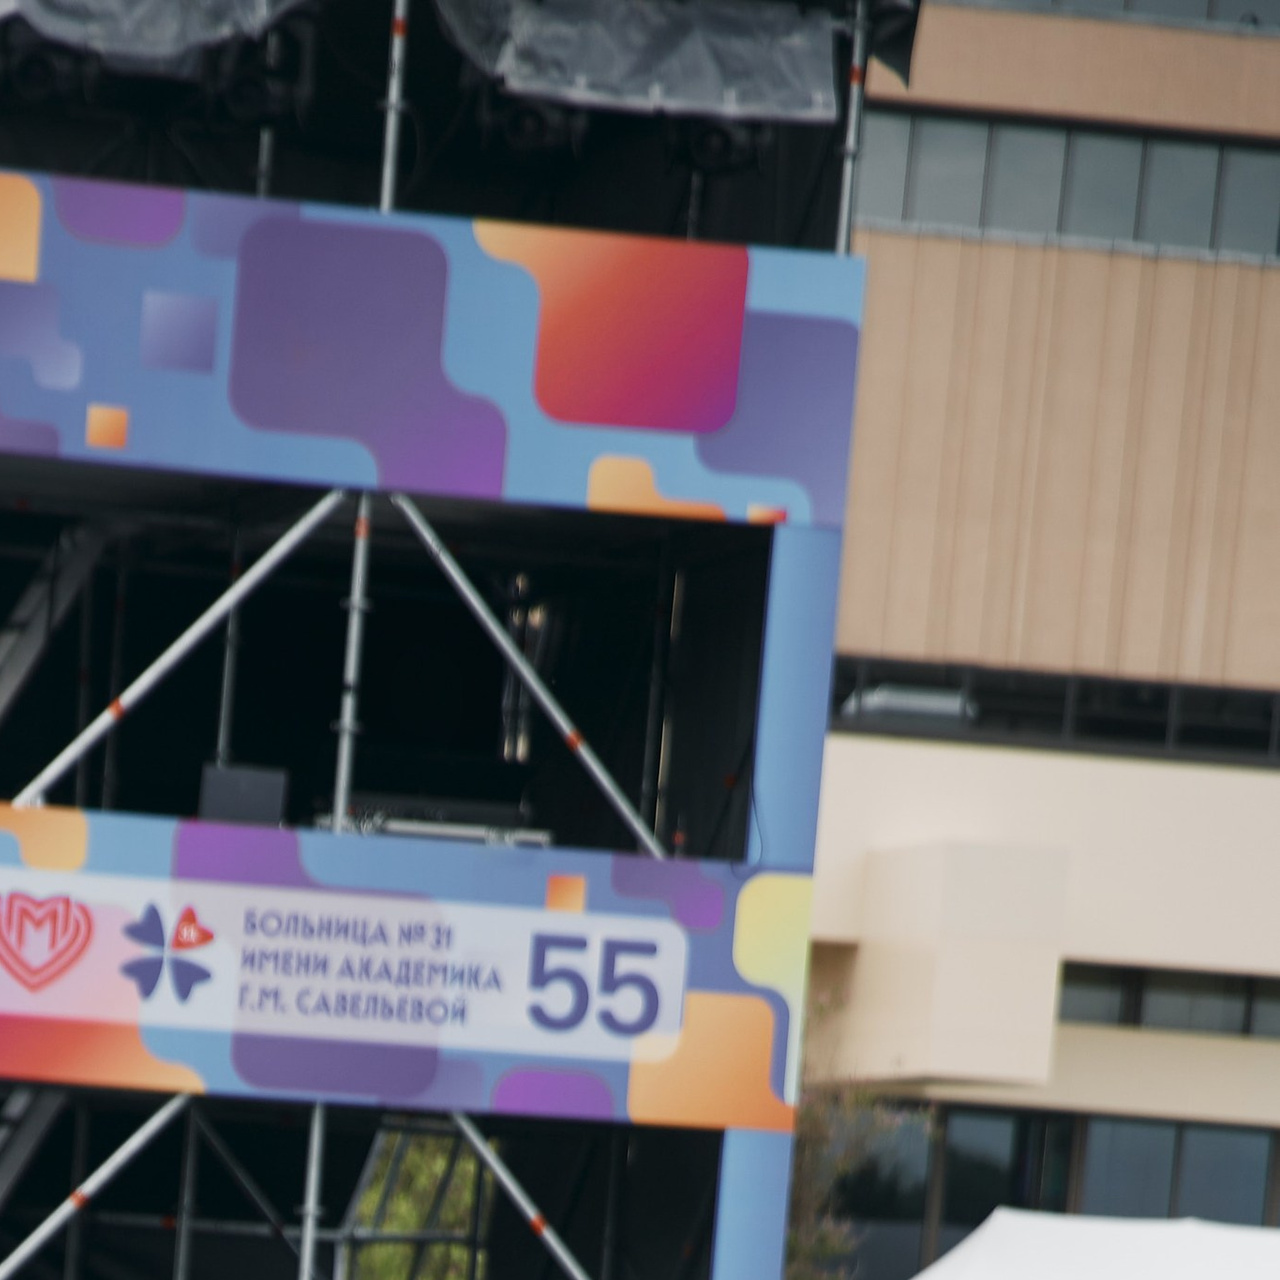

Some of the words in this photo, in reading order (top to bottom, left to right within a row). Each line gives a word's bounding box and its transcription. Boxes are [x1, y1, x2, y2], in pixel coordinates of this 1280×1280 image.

[243, 907, 389, 947] БОЛЬНИЦА
[240, 948, 330, 977] ИМЕНИ
[336, 954, 504, 992] АКАДЕМИКА
[528, 932, 660, 1036] 55
[295, 985, 469, 1026] САВЕЛЬЕВОЙ
